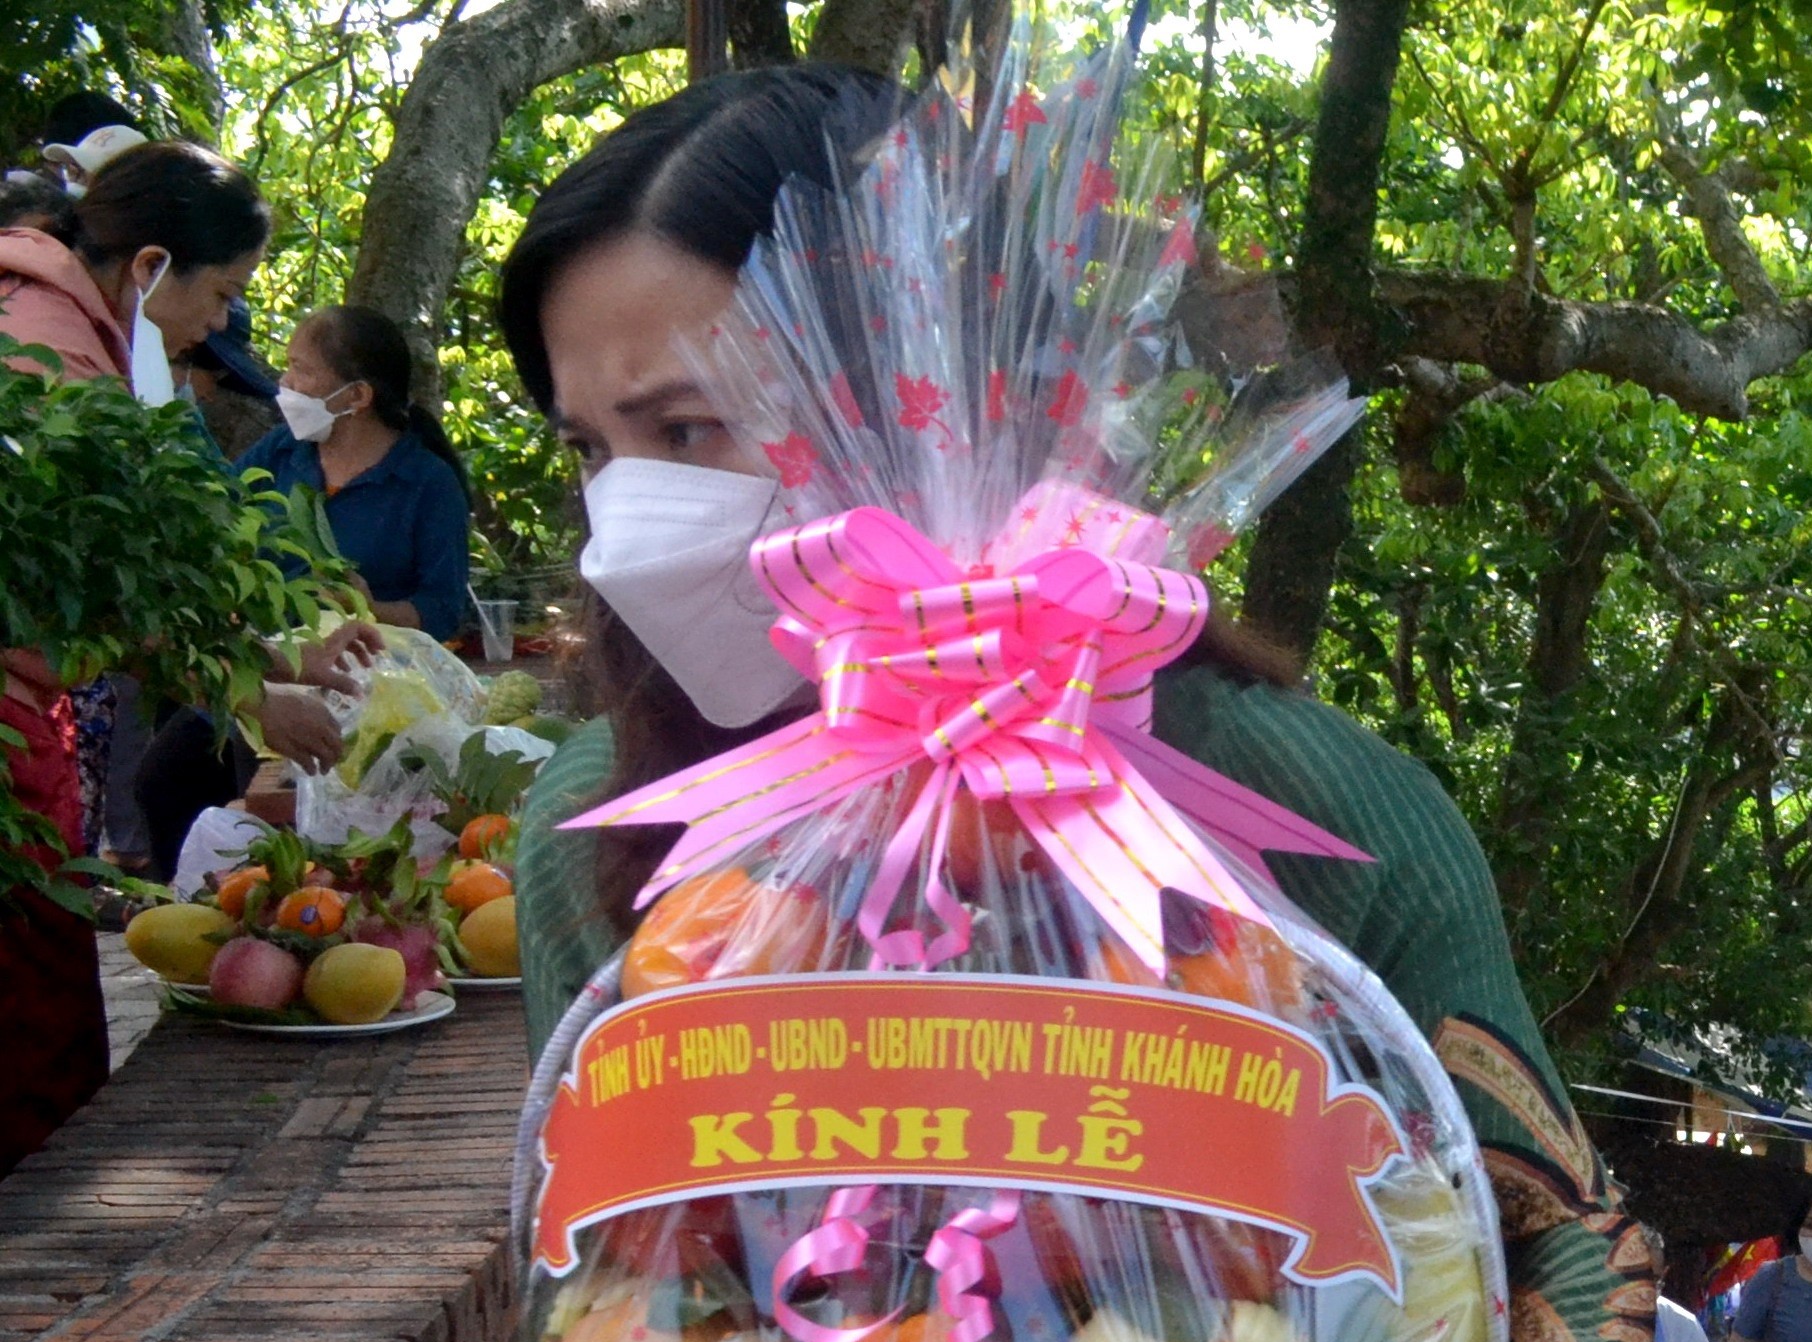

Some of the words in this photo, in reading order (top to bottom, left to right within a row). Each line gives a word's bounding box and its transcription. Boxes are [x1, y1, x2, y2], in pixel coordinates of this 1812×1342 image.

[588, 1037, 631, 1108] TỈNH
[635, 1018, 666, 1089] ỦY
[866, 1016, 1034, 1081] UBMTTQVN
[1042, 1005, 1114, 1080] TỈNH
[1120, 1024, 1233, 1096] KHÁNH
[1234, 1046, 1302, 1118] HÒA
[687, 1092, 974, 1168] KÍNH
[1004, 1084, 1145, 1172] LỄ
